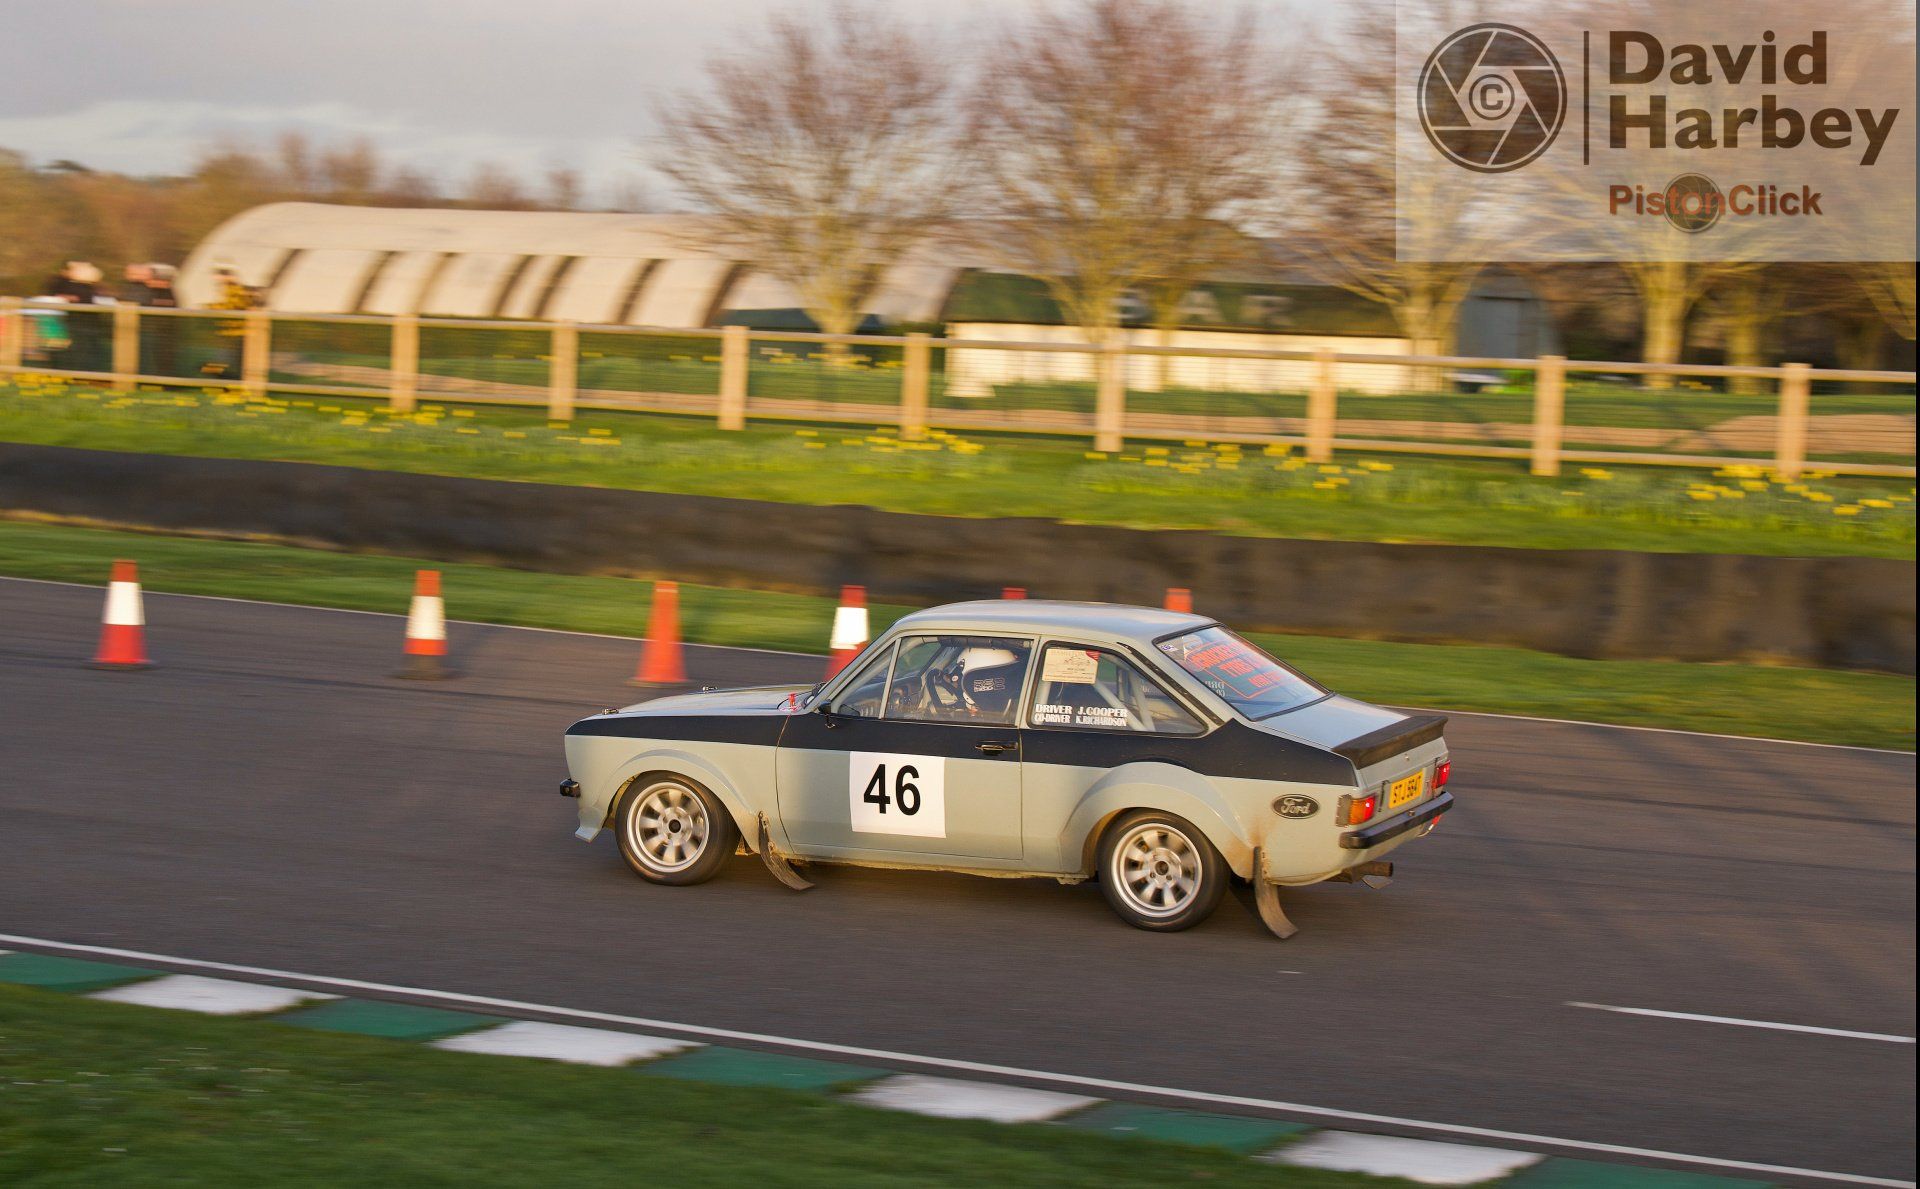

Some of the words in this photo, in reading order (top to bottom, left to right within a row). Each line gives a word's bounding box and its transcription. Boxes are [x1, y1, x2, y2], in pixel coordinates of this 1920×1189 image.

[1035, 703, 1073, 715] DRIVER
[1077, 706, 1128, 717] J.COOPER
[1034, 713, 1071, 723] CO-DRIVER
[863, 764, 921, 816] 46
[1280, 797, 1311, 814] Ford
